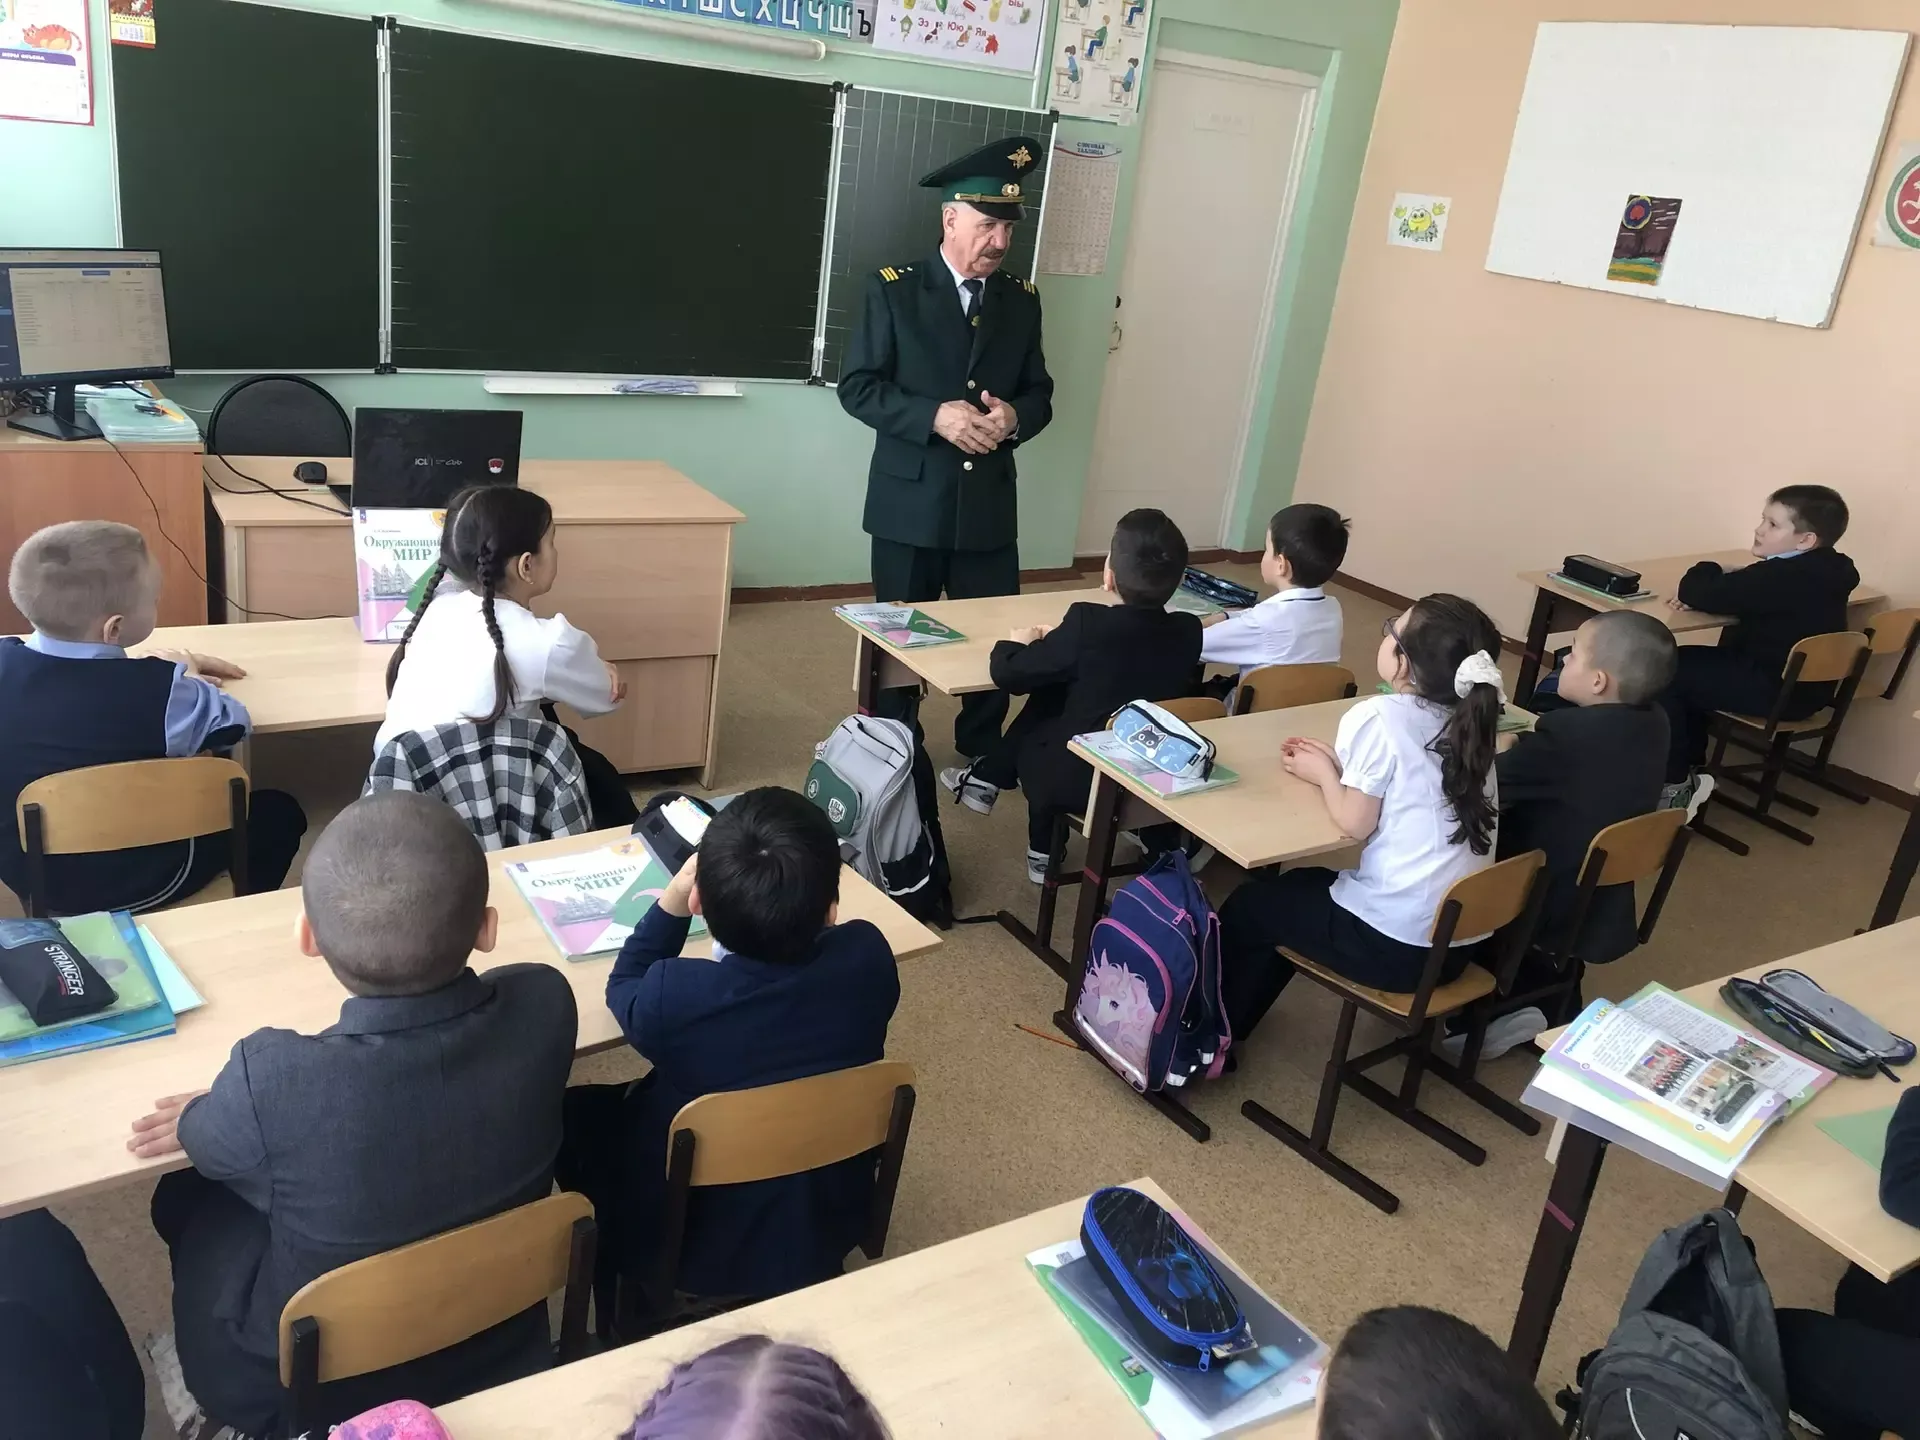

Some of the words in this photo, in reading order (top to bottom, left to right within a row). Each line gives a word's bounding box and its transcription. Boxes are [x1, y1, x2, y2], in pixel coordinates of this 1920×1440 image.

[782, 0, 800, 30] Ц
[808, 0, 823, 30] Ч
[829, 4, 851, 38] Щ
[393, 548, 432, 561] МИР
[914, 619, 950, 635] 3
[531, 864, 637, 889] Окружающий
[574, 875, 625, 892] МИР
[44, 944, 85, 996] STRANGER
